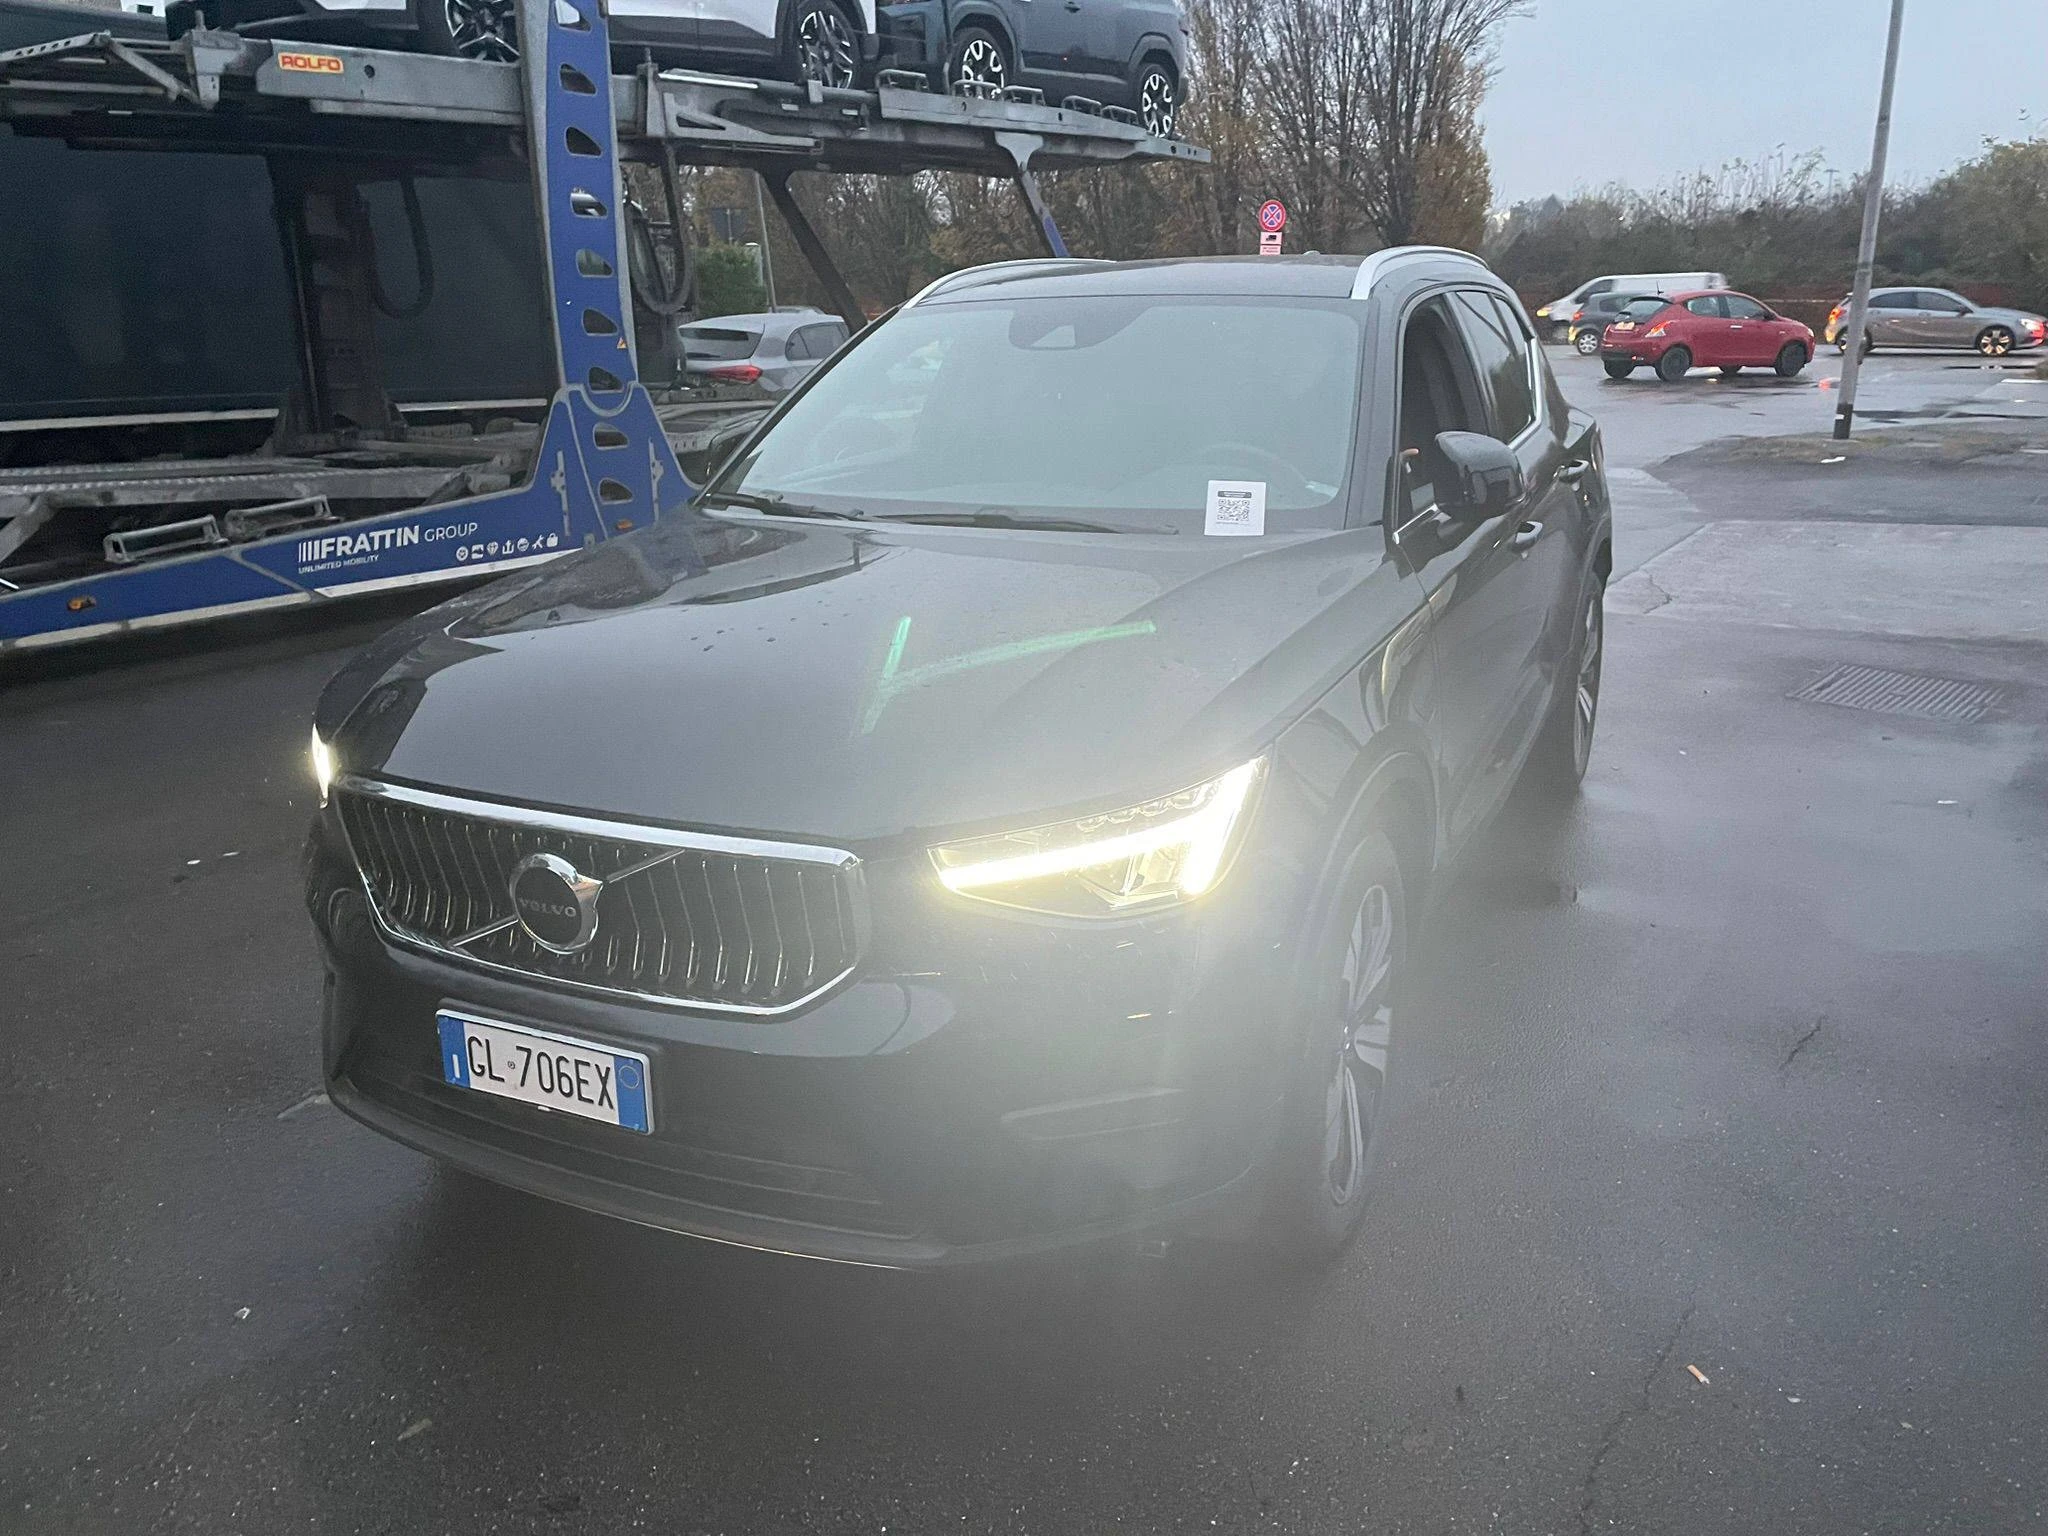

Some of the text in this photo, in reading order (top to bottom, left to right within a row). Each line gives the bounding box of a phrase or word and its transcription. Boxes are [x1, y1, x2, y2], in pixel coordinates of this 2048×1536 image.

[281, 55, 341, 71] ROLFO
[424, 522, 478, 542] GROUP
[298, 554, 379, 574] UNLIMITED MOBILITY
[519, 897, 577, 917] VOLVO
